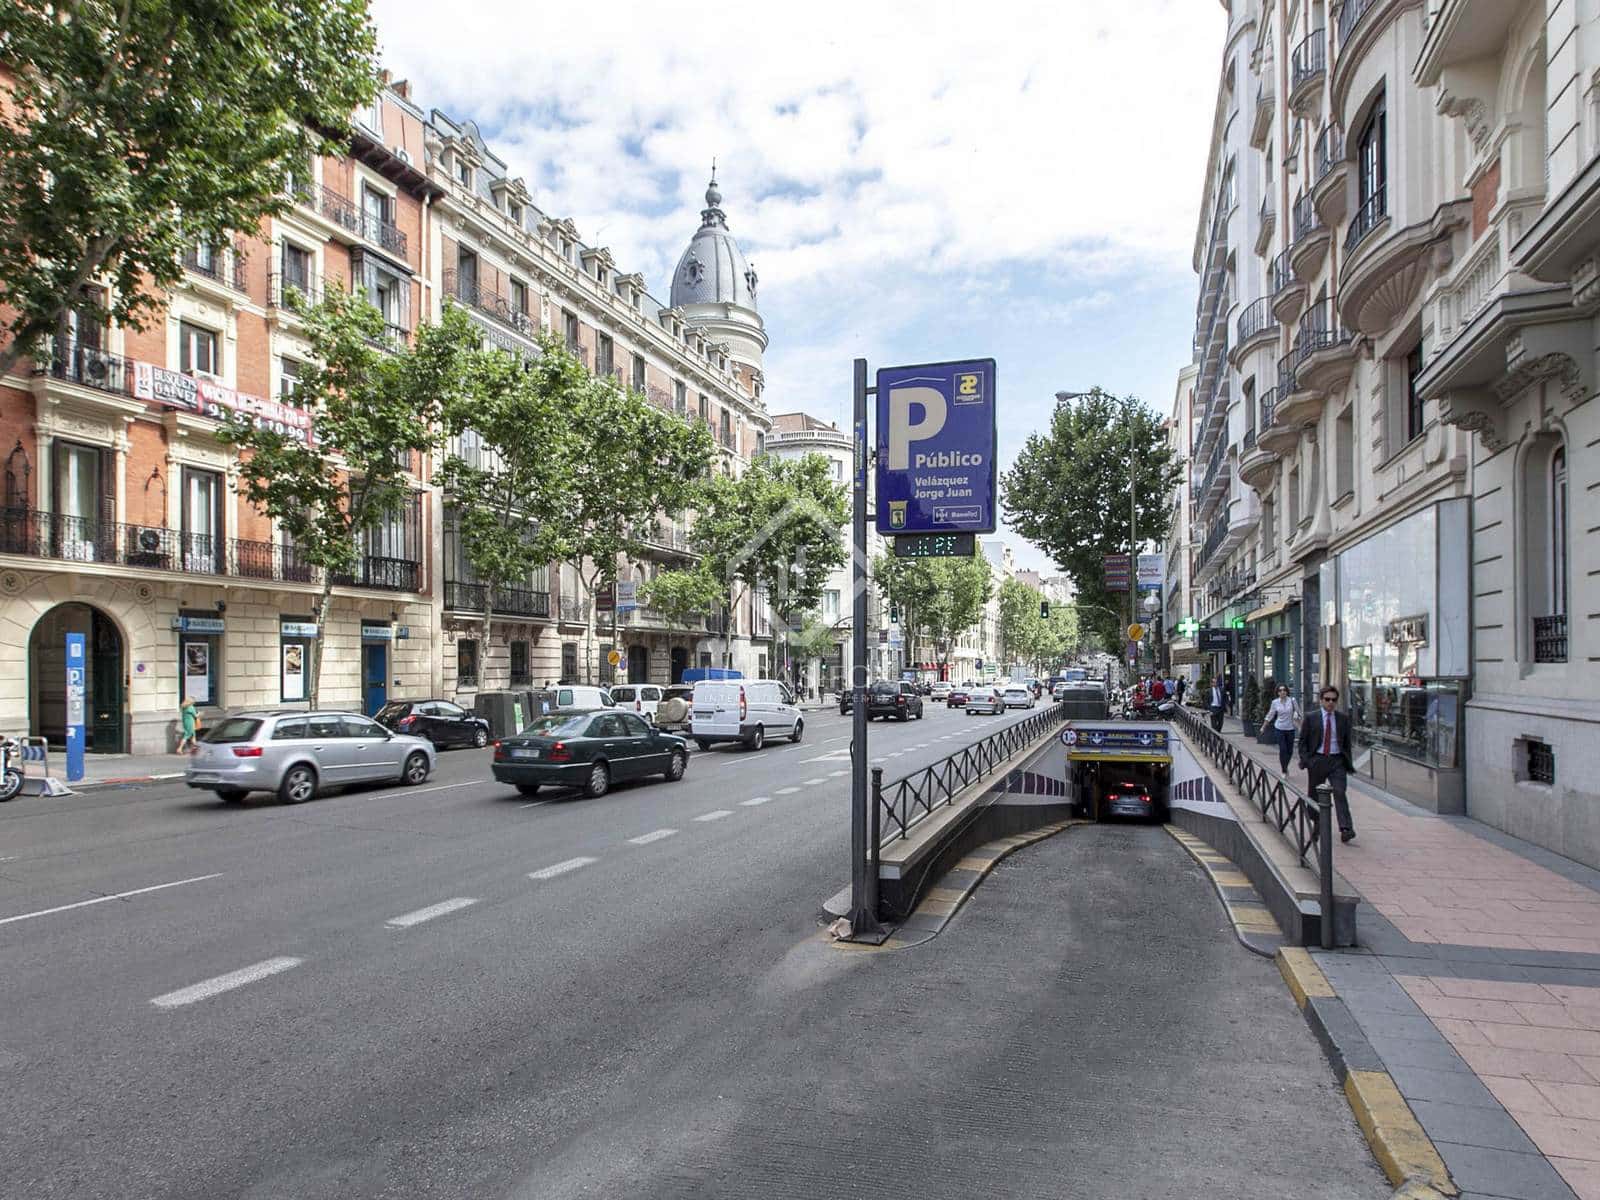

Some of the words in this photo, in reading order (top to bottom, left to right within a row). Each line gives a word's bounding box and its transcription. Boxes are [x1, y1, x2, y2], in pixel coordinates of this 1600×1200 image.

[153, 367, 198, 390] BUSQUETS
[153, 382, 198, 404] GALVEZ
[888, 386, 948, 471] P
[915, 450, 983, 469] Público
[914, 476, 969, 488] Velázquez
[914, 489, 944, 500] Jorge
[946, 487, 973, 498] Juan
